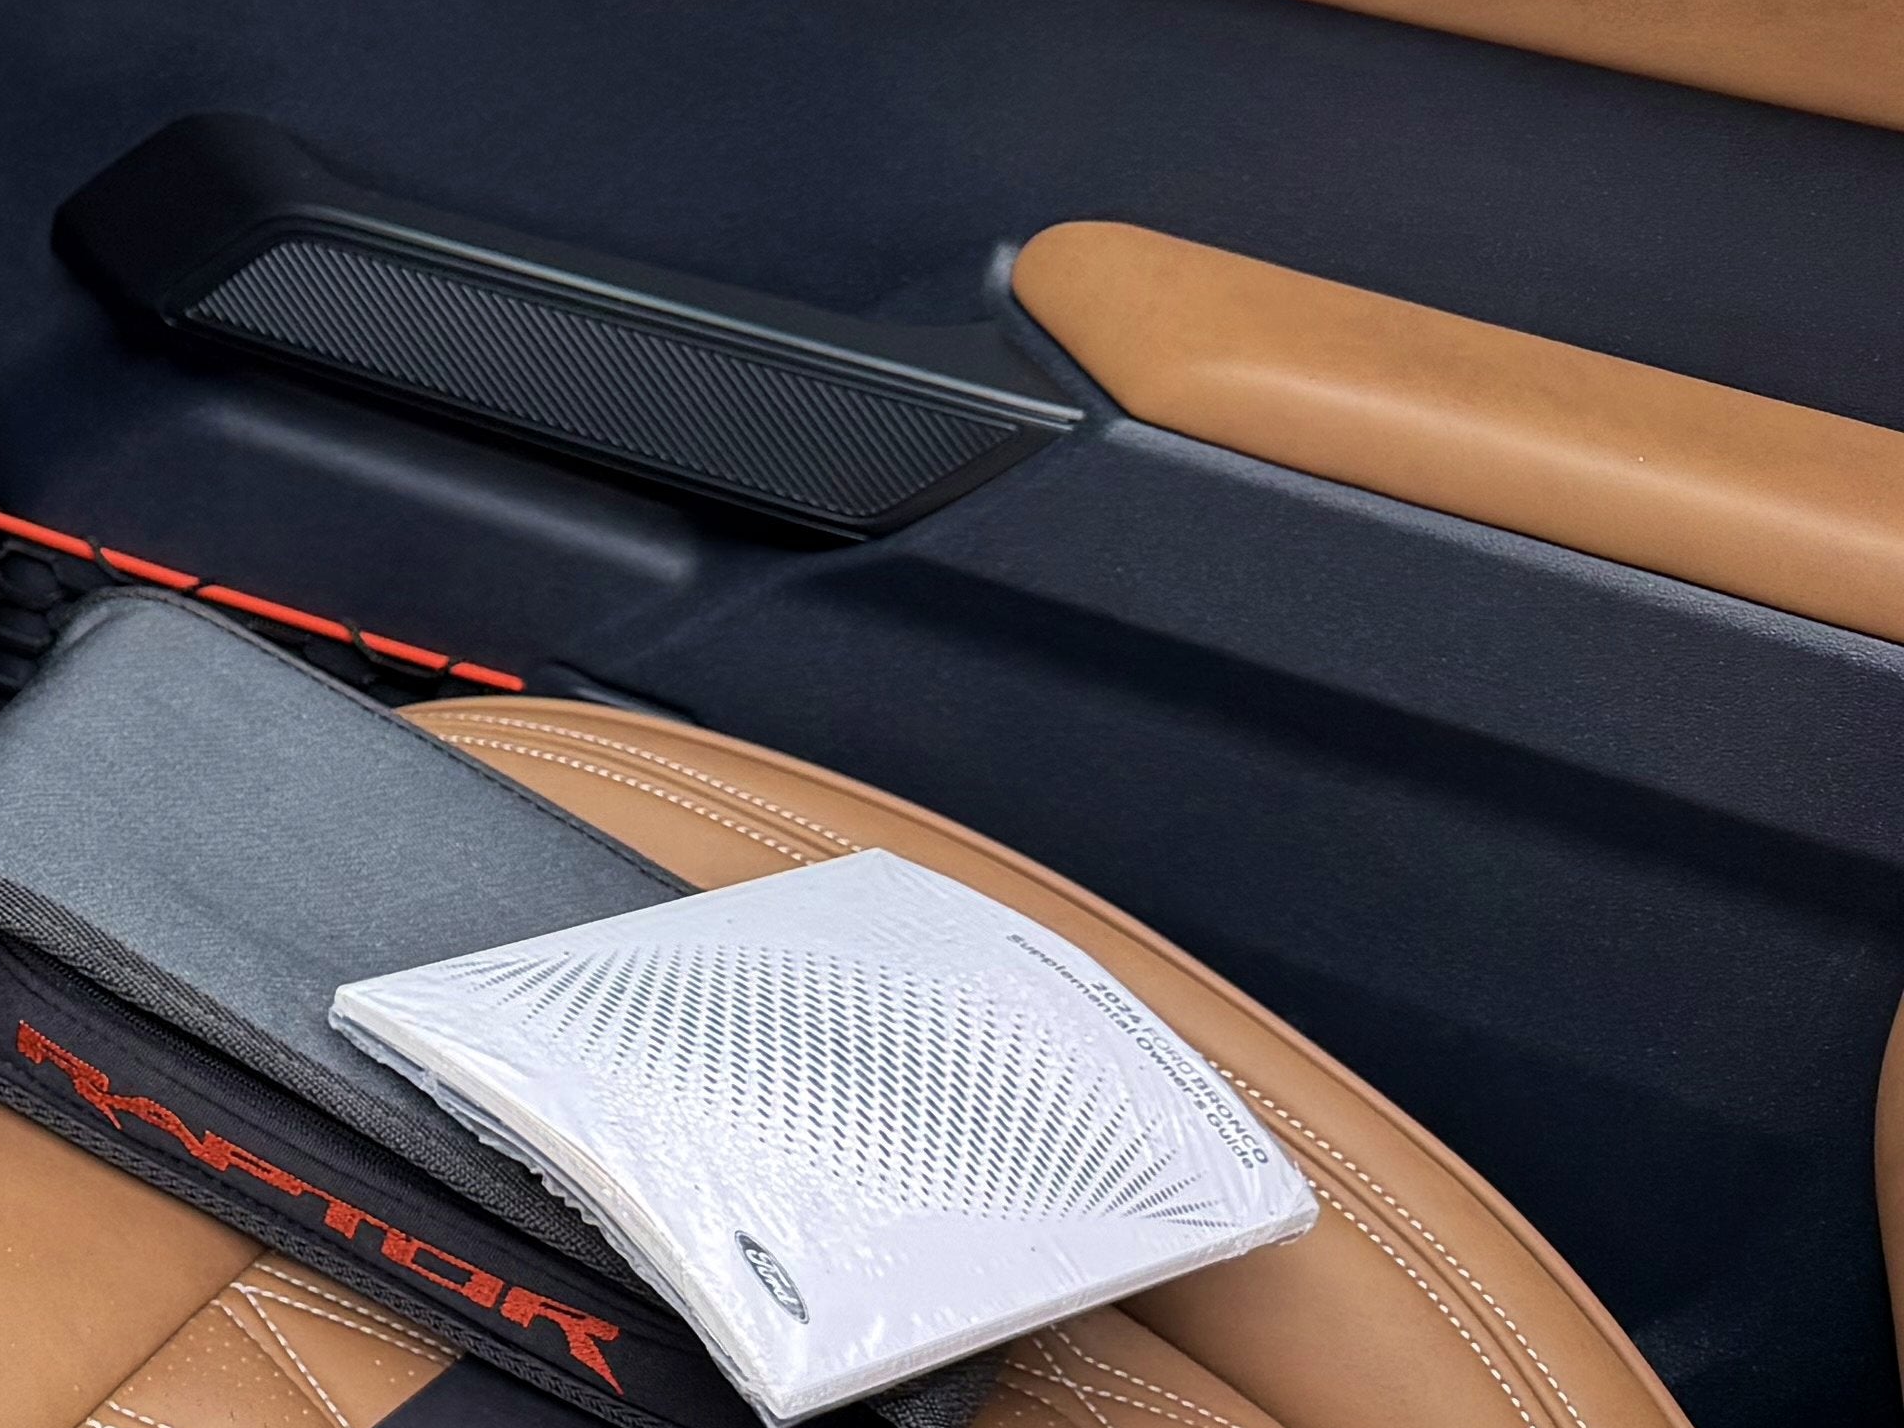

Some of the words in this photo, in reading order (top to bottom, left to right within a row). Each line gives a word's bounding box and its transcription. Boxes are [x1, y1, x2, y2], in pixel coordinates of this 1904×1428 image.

[1005, 933, 1137, 1036] Supplemental
[1135, 1036, 1208, 1111] Owner's
[1206, 1113, 1255, 1171] Guide
[1090, 981, 1142, 1025] 2024
[1141, 1027, 1194, 1075] FORD
[1191, 1076, 1270, 1166] BRONCO
[15, 1018, 626, 1396] RAPTOR
